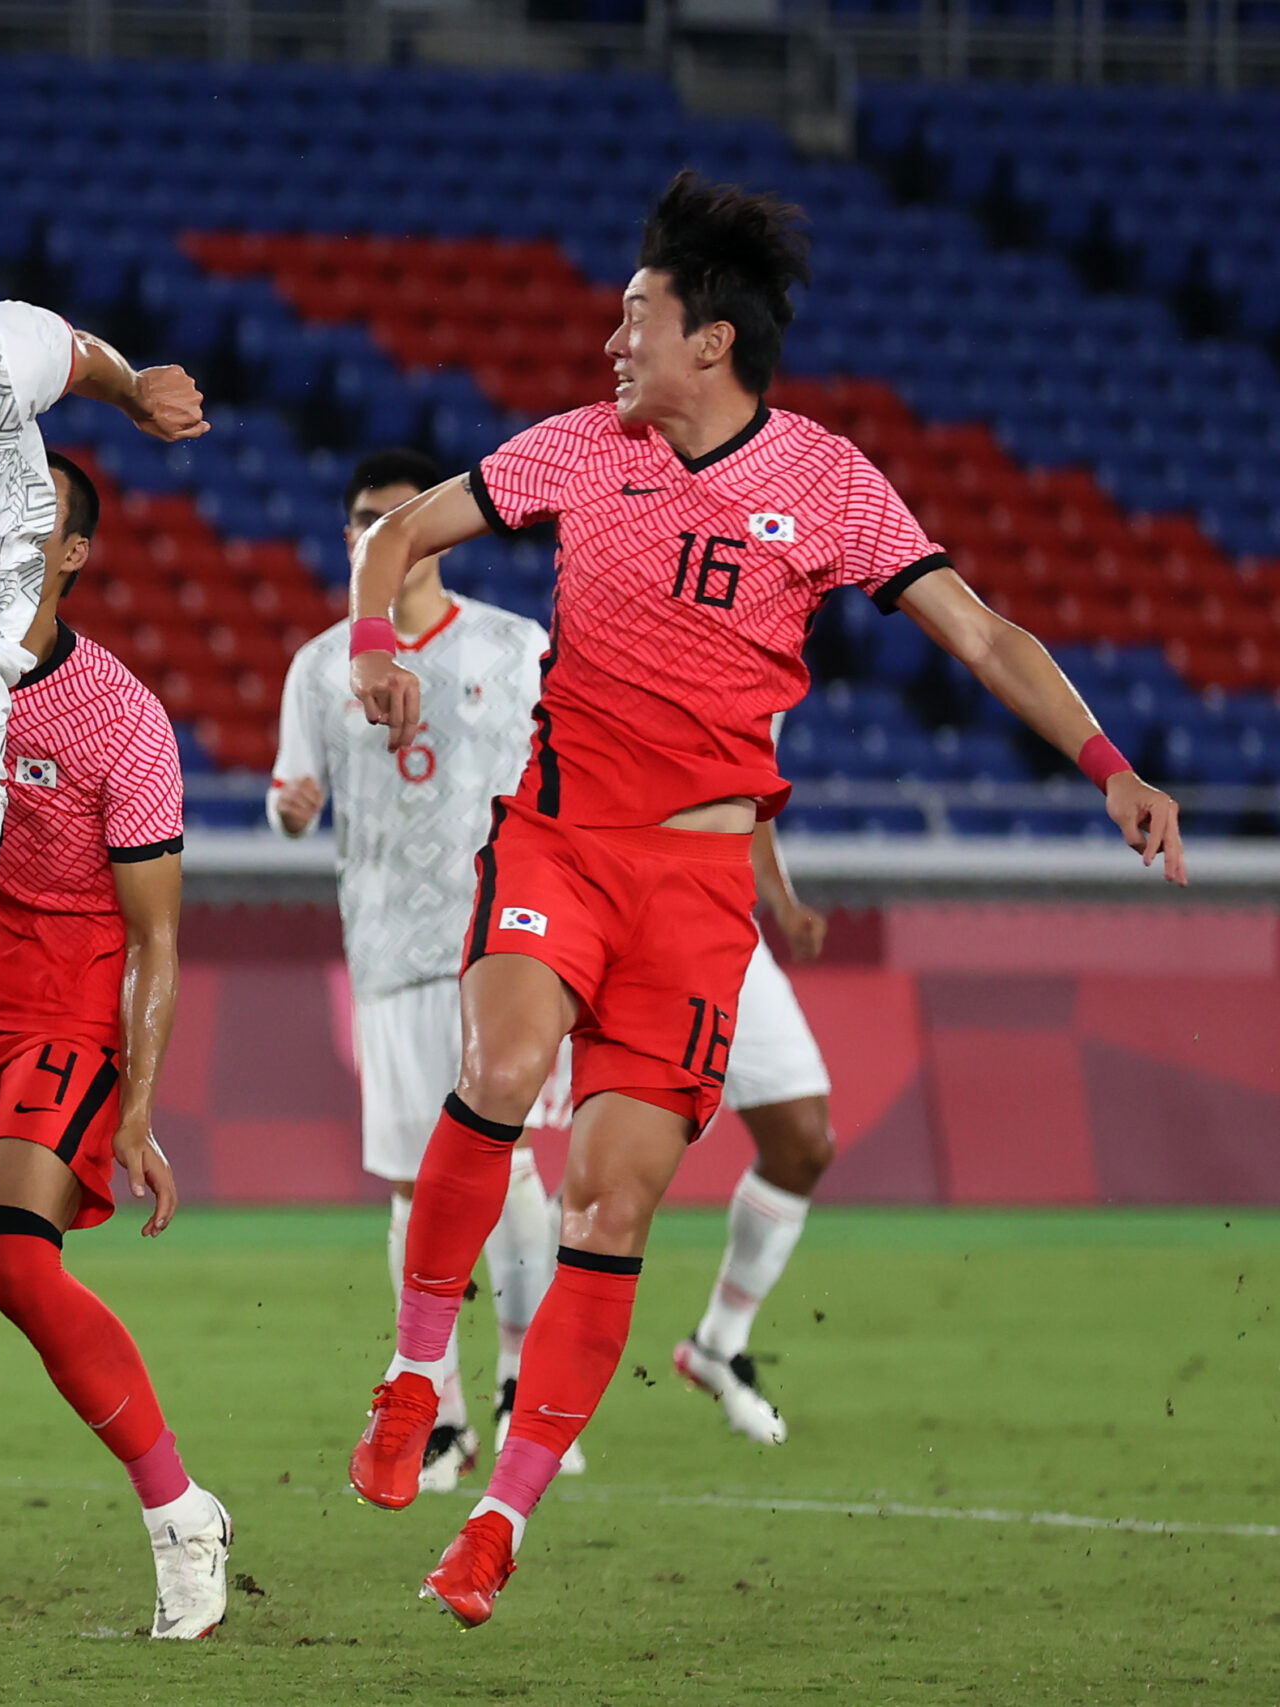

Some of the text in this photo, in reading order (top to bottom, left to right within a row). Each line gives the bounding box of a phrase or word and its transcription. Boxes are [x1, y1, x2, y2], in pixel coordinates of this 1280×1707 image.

[673, 531, 746, 610] 16
[397, 722, 436, 785] 6
[36, 1044, 78, 1105] 4
[681, 997, 729, 1083] 16
